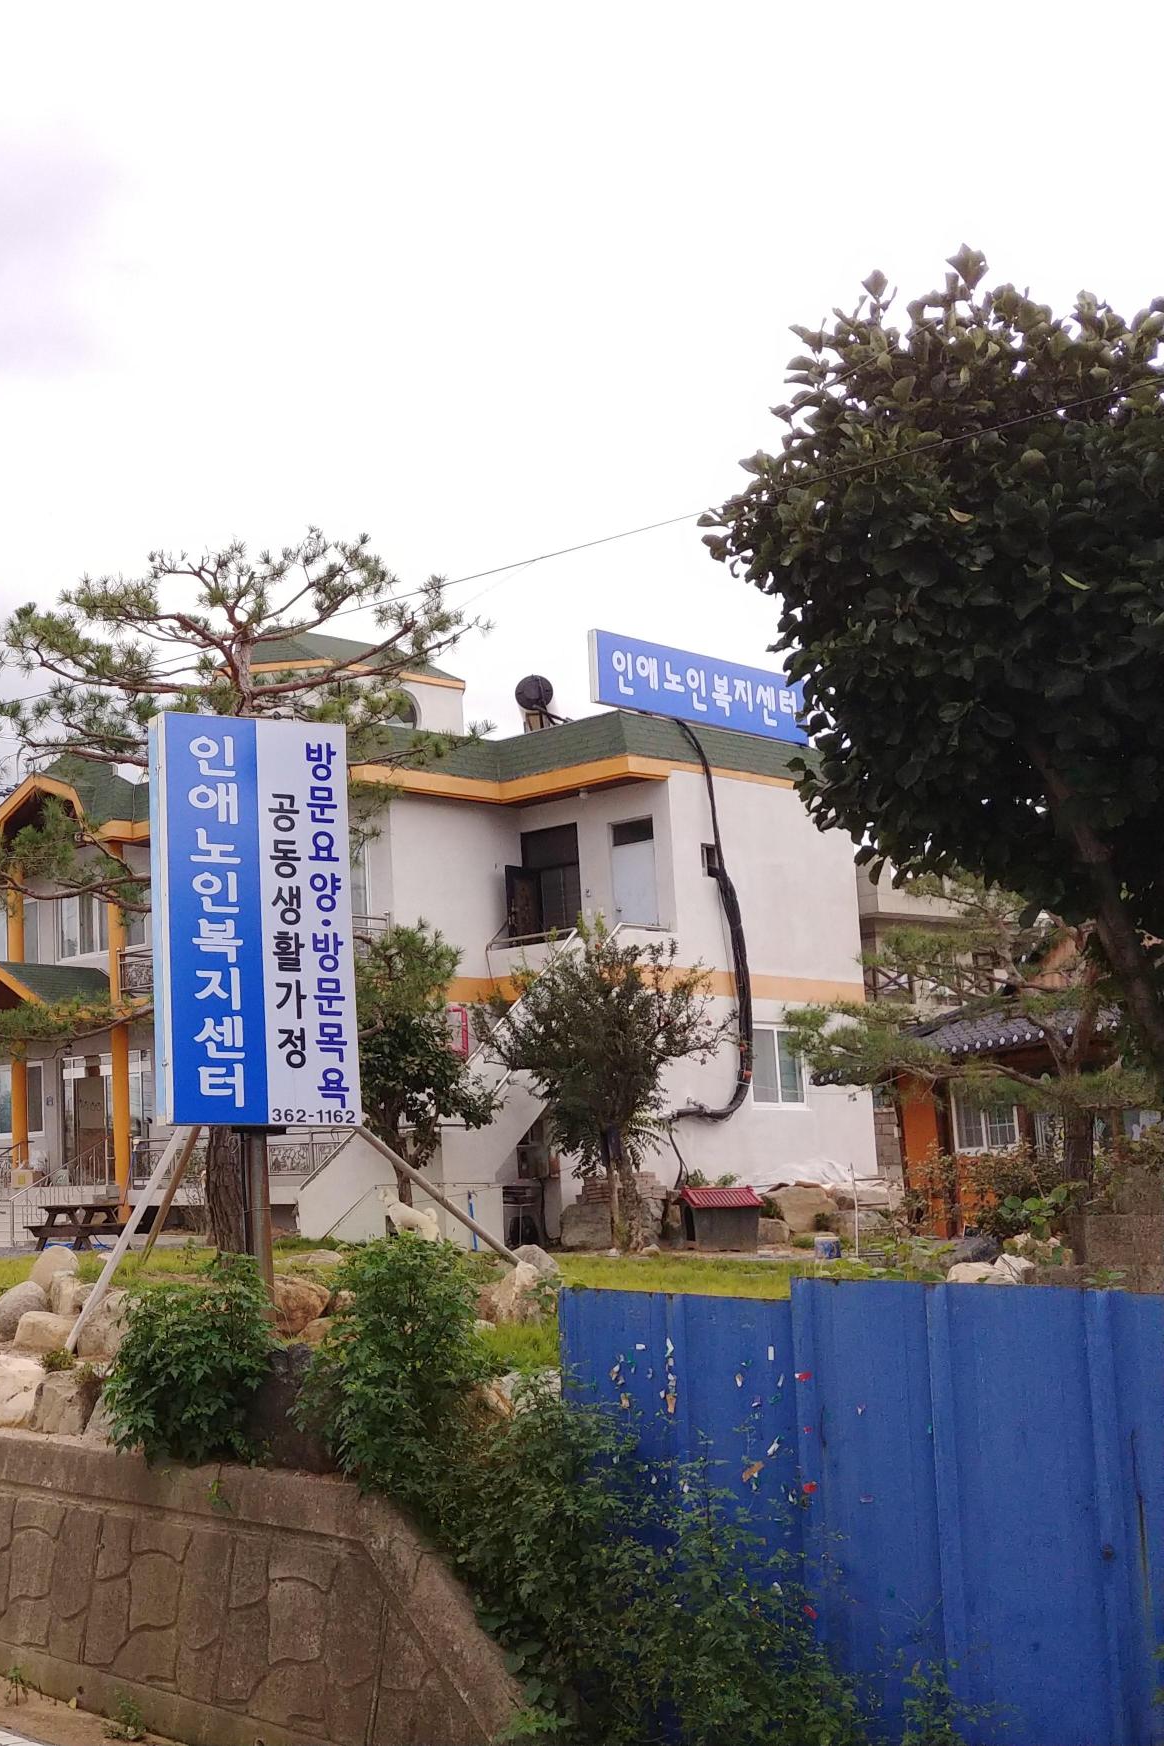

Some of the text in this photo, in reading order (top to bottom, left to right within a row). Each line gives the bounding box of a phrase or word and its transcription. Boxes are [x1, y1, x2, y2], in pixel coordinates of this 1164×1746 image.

[188, 735, 246, 1108] 인애노인복지센터
[267, 793, 308, 1069] 공동생활가정
[272, 1108, 356, 1124] 362-1162
